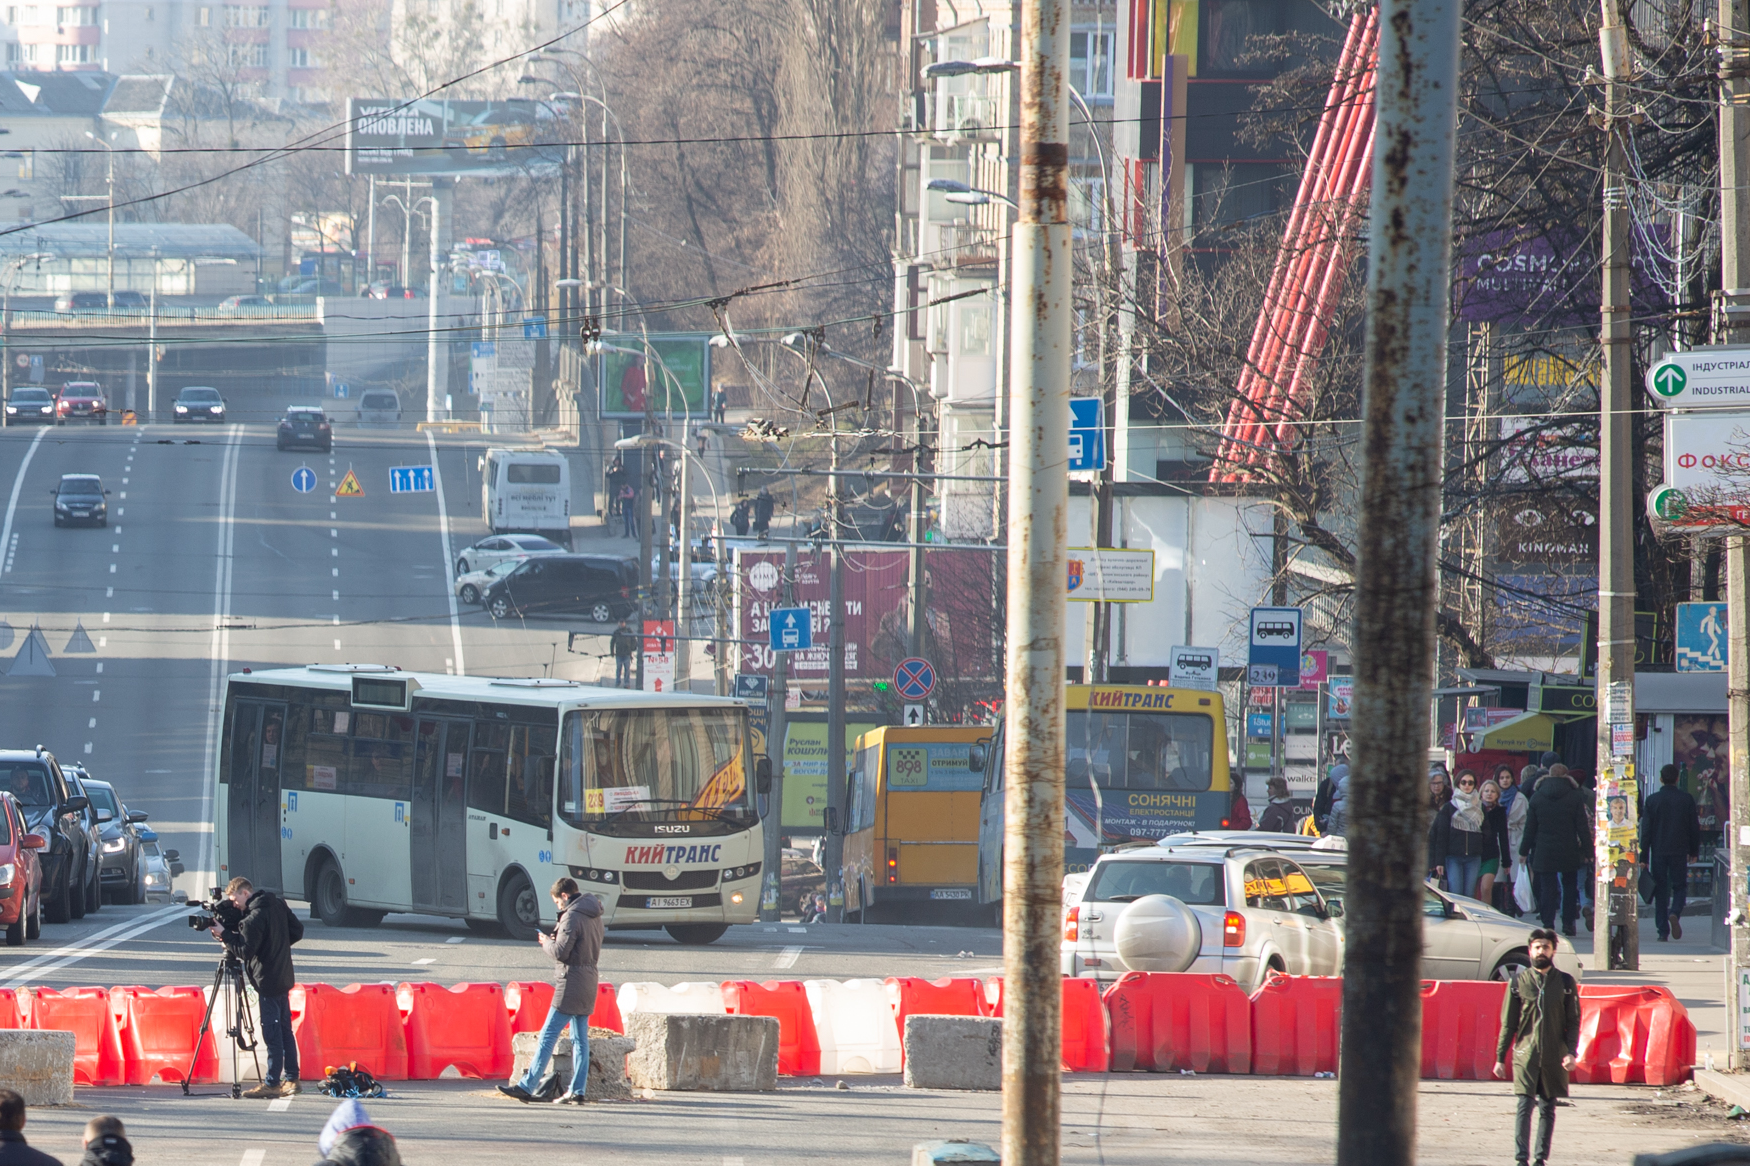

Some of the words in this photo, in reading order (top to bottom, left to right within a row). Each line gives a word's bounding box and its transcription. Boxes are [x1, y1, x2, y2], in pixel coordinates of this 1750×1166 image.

[358, 117, 434, 135] ОНОВЛЕНА
[1519, 542, 1589, 554] KINOMAN
[1090, 690, 1174, 709] КИЙТРАНС
[896, 760, 922, 777] 898
[931, 759, 968, 767] ОТРИМУЙ
[1128, 794, 1196, 807] СОНЯЧНІ
[1129, 808, 1196, 817] ЕЛЕКТРОСТАНЦІЇ
[654, 825, 690, 833] ISUZU
[1149, 819, 1196, 827] ПОДАРУНОК!
[624, 844, 721, 864] КИЙТРАНС
[662, 897, 680, 906] 9663
